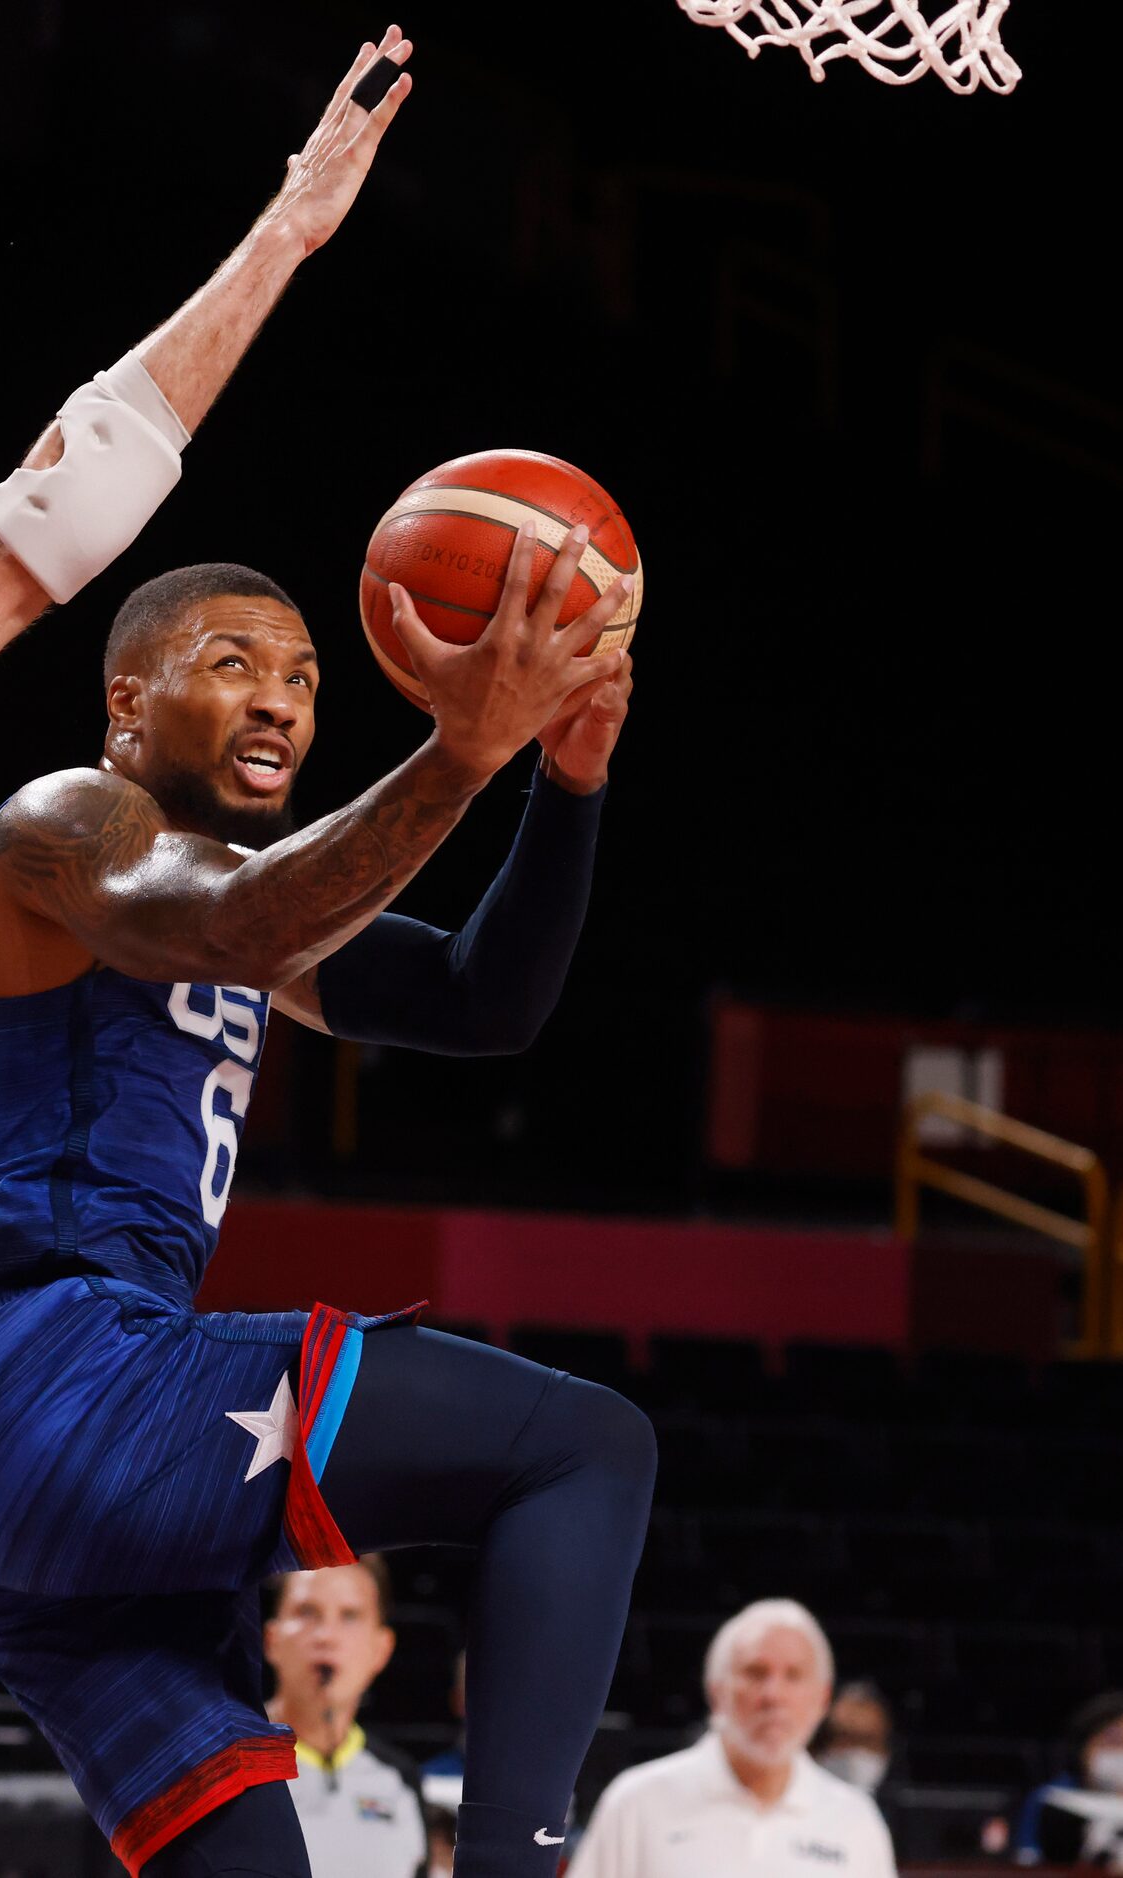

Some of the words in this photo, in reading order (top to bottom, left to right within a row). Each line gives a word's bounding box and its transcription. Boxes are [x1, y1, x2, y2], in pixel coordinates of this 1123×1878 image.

[420, 544, 469, 571] OKYO
[167, 982, 271, 1065] US
[199, 1058, 254, 1229] 6
